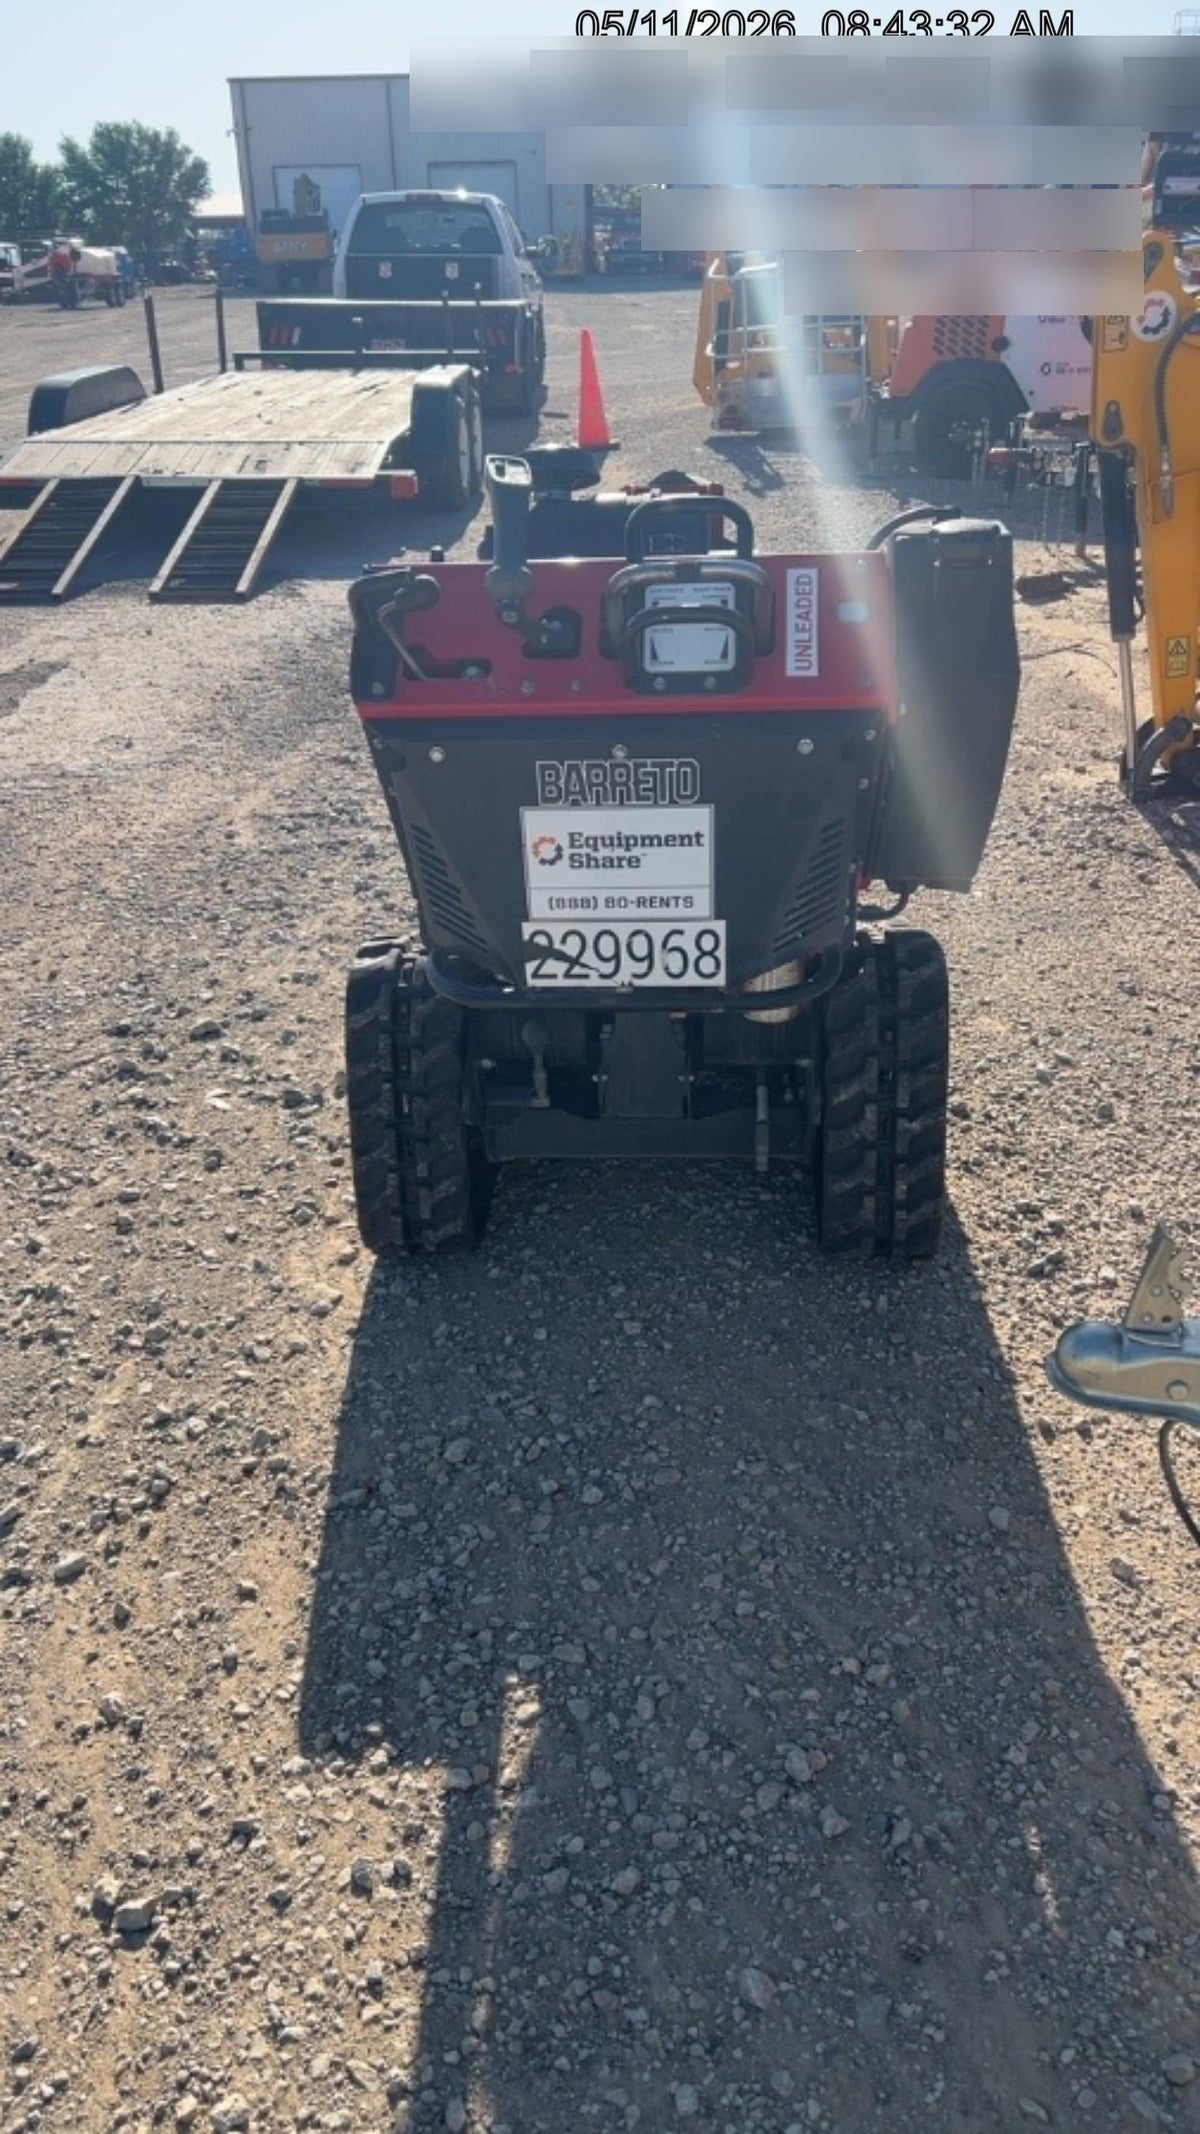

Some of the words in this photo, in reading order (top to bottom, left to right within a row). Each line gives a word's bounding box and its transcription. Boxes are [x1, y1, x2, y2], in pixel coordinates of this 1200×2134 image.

[794, 573, 812, 671] UNLEADED
[536, 758, 700, 805] BARRETO
[567, 831, 705, 852] Equipment
[604, 896, 694, 909] 80-RENTS
[527, 929, 721, 980] 229968
